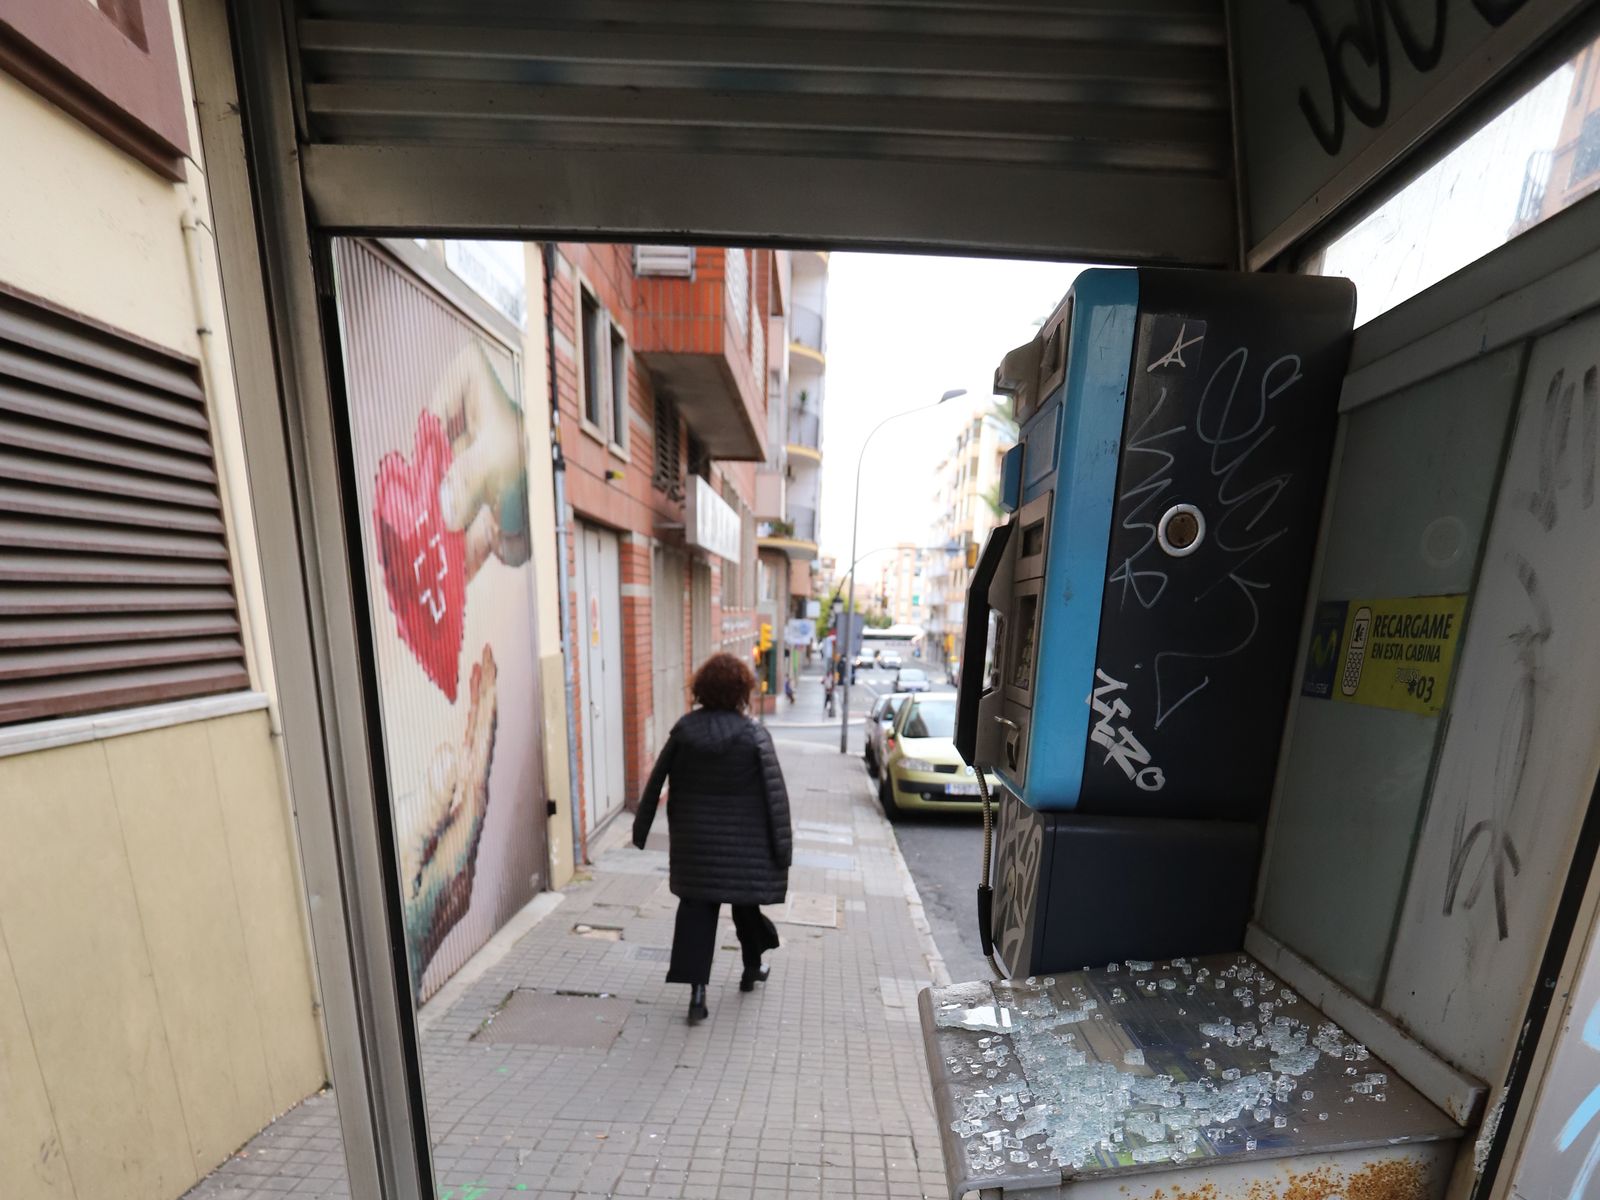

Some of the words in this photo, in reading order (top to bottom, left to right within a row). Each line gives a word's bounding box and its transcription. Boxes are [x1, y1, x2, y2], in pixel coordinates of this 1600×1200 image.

[1372, 613, 1454, 640] RECARGAME
[1371, 642, 1384, 660] EN
[1384, 643, 1404, 661] ESTA
[1405, 644, 1441, 663] CABINA
